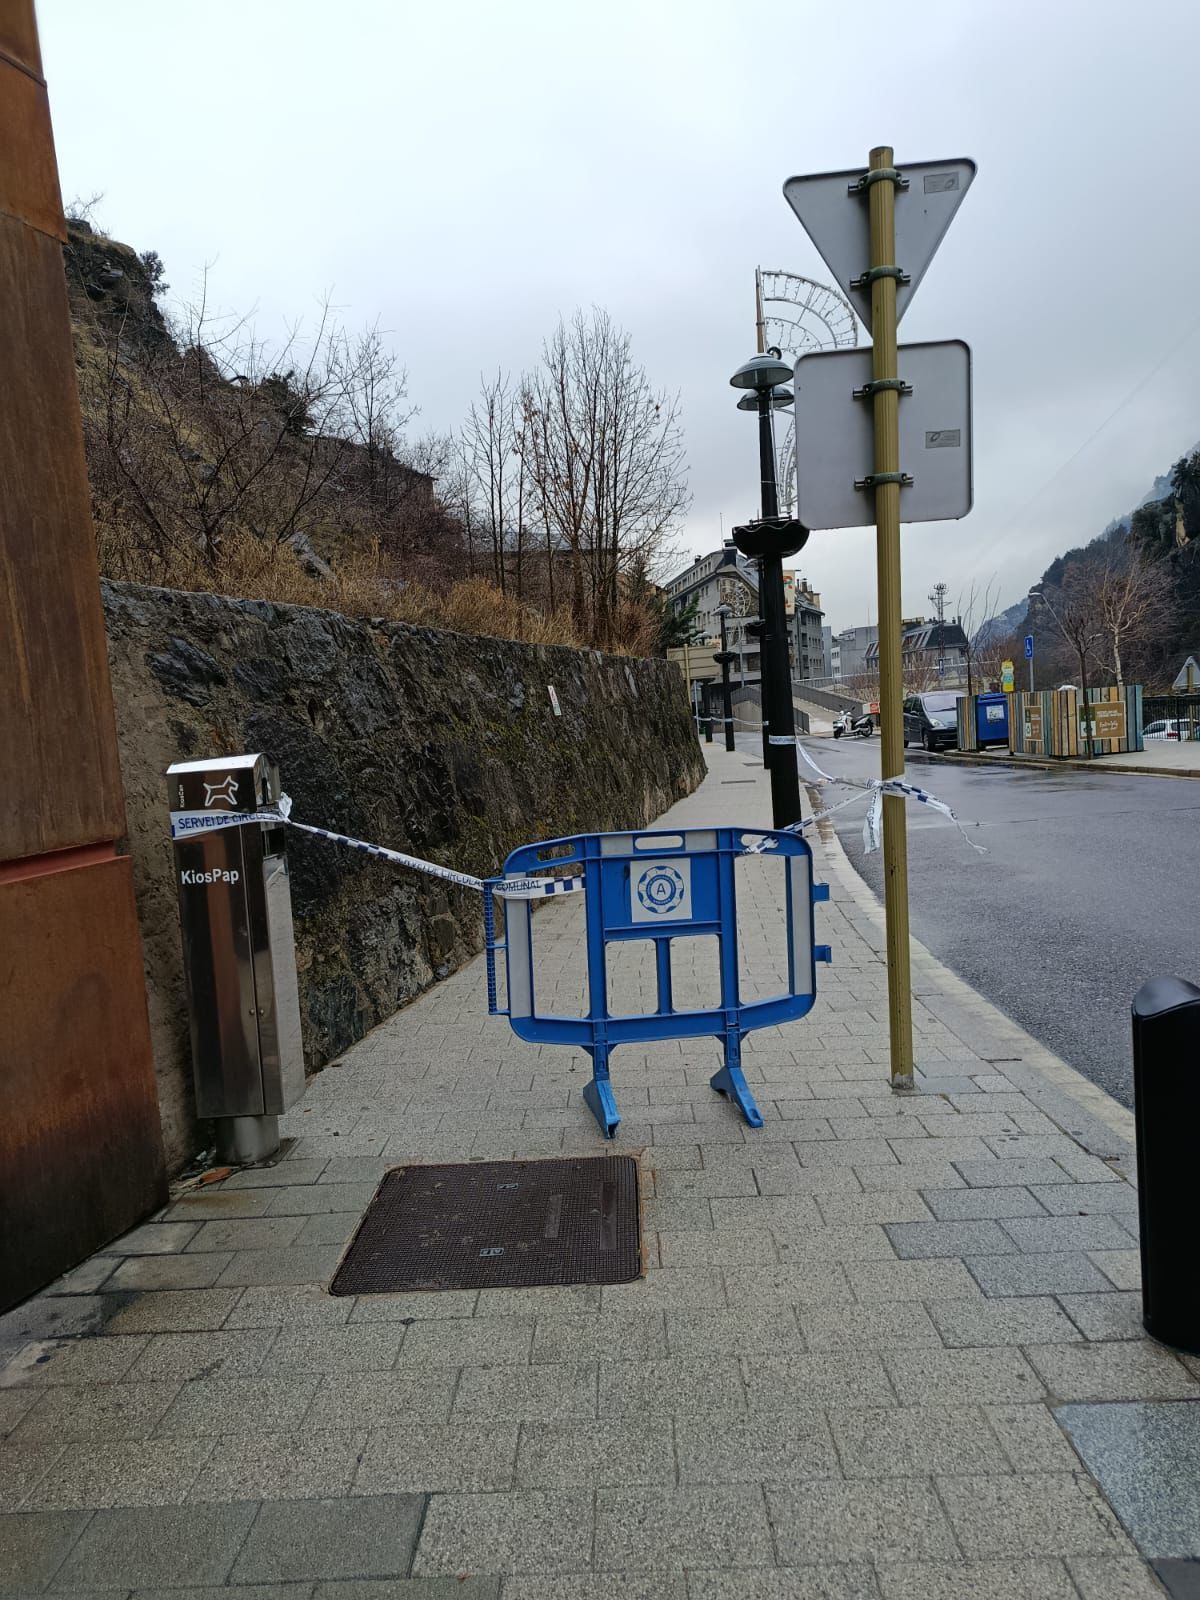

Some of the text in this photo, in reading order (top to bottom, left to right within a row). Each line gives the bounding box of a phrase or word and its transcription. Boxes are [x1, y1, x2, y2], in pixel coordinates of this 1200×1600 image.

[178, 815, 215, 829] SERVEI
[216, 815, 230, 825] DE
[181, 868, 239, 885] KiosPap
